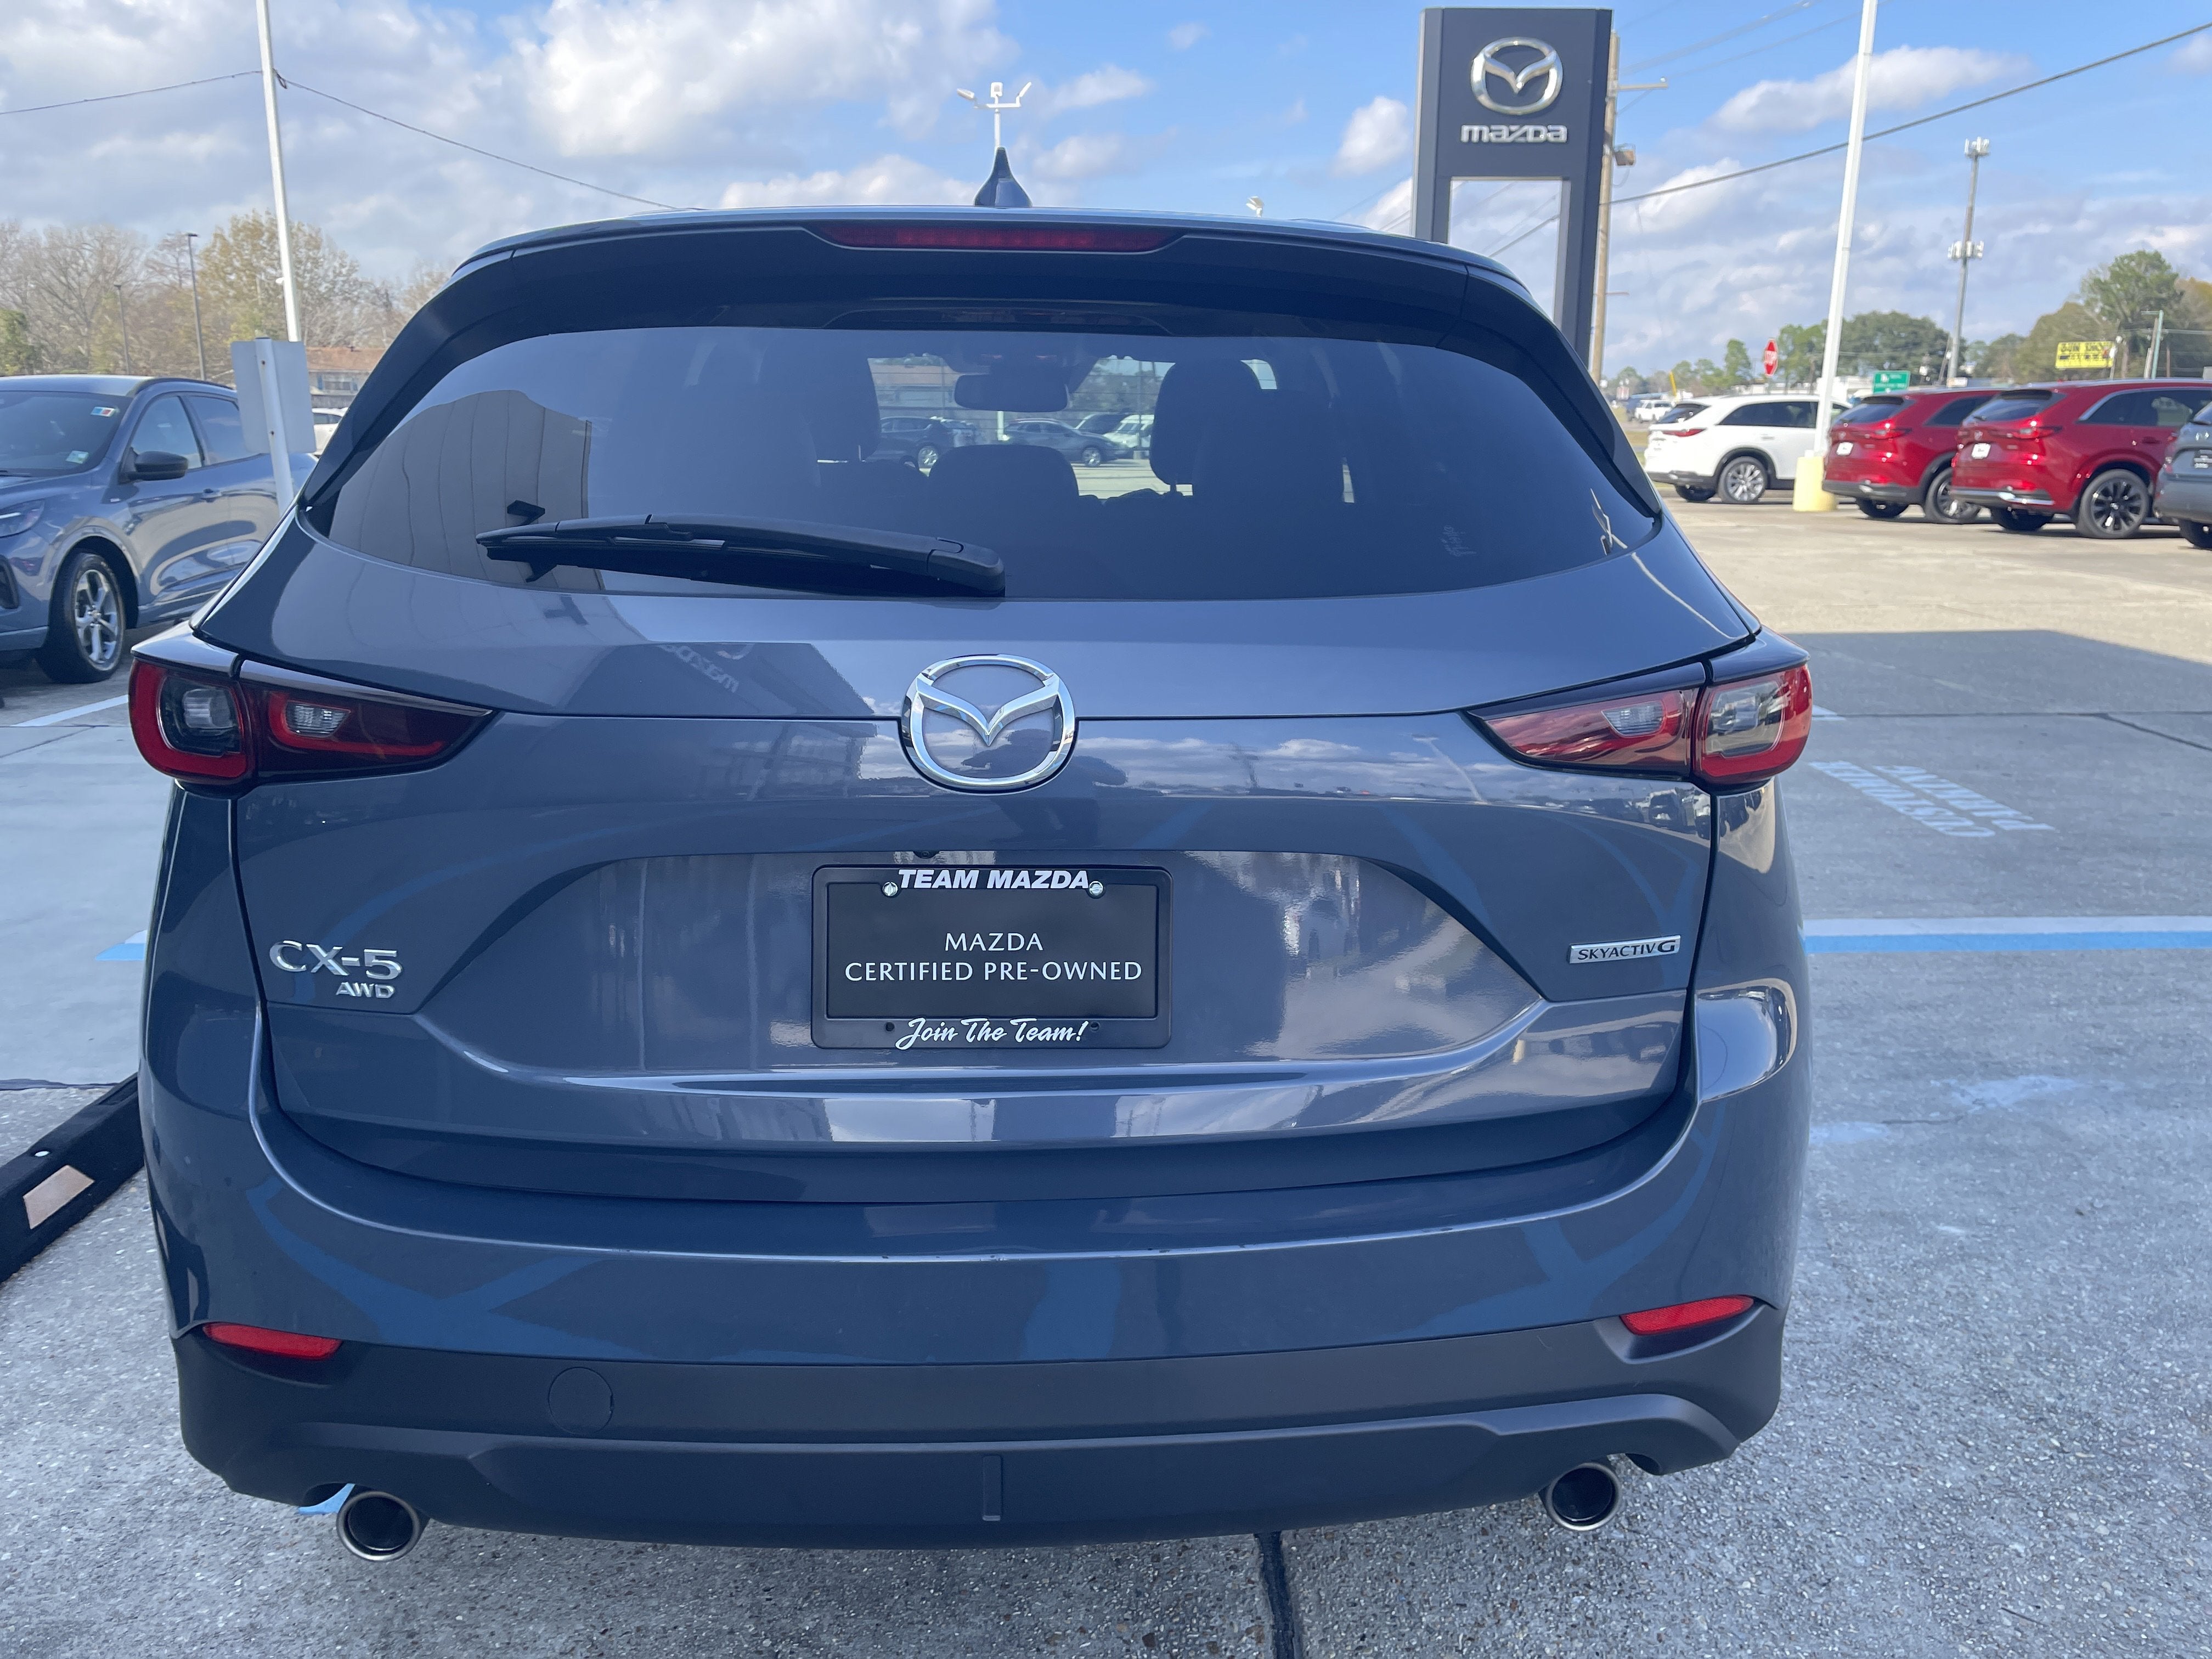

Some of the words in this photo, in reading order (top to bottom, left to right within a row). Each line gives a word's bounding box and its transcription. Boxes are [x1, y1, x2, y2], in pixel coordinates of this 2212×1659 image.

[898, 869, 979, 889] TEAM
[986, 870, 1089, 889] MAZDA
[944, 933, 1043, 951] MAZDA
[269, 939, 403, 980] CX-5
[844, 962, 973, 981] CERTIFIED
[984, 962, 1142, 980] PRE-OWNED
[335, 981, 396, 999] AWD
[895, 1017, 958, 1051] Join
[960, 1017, 1008, 1043] The
[1009, 1017, 1090, 1043] Team!
